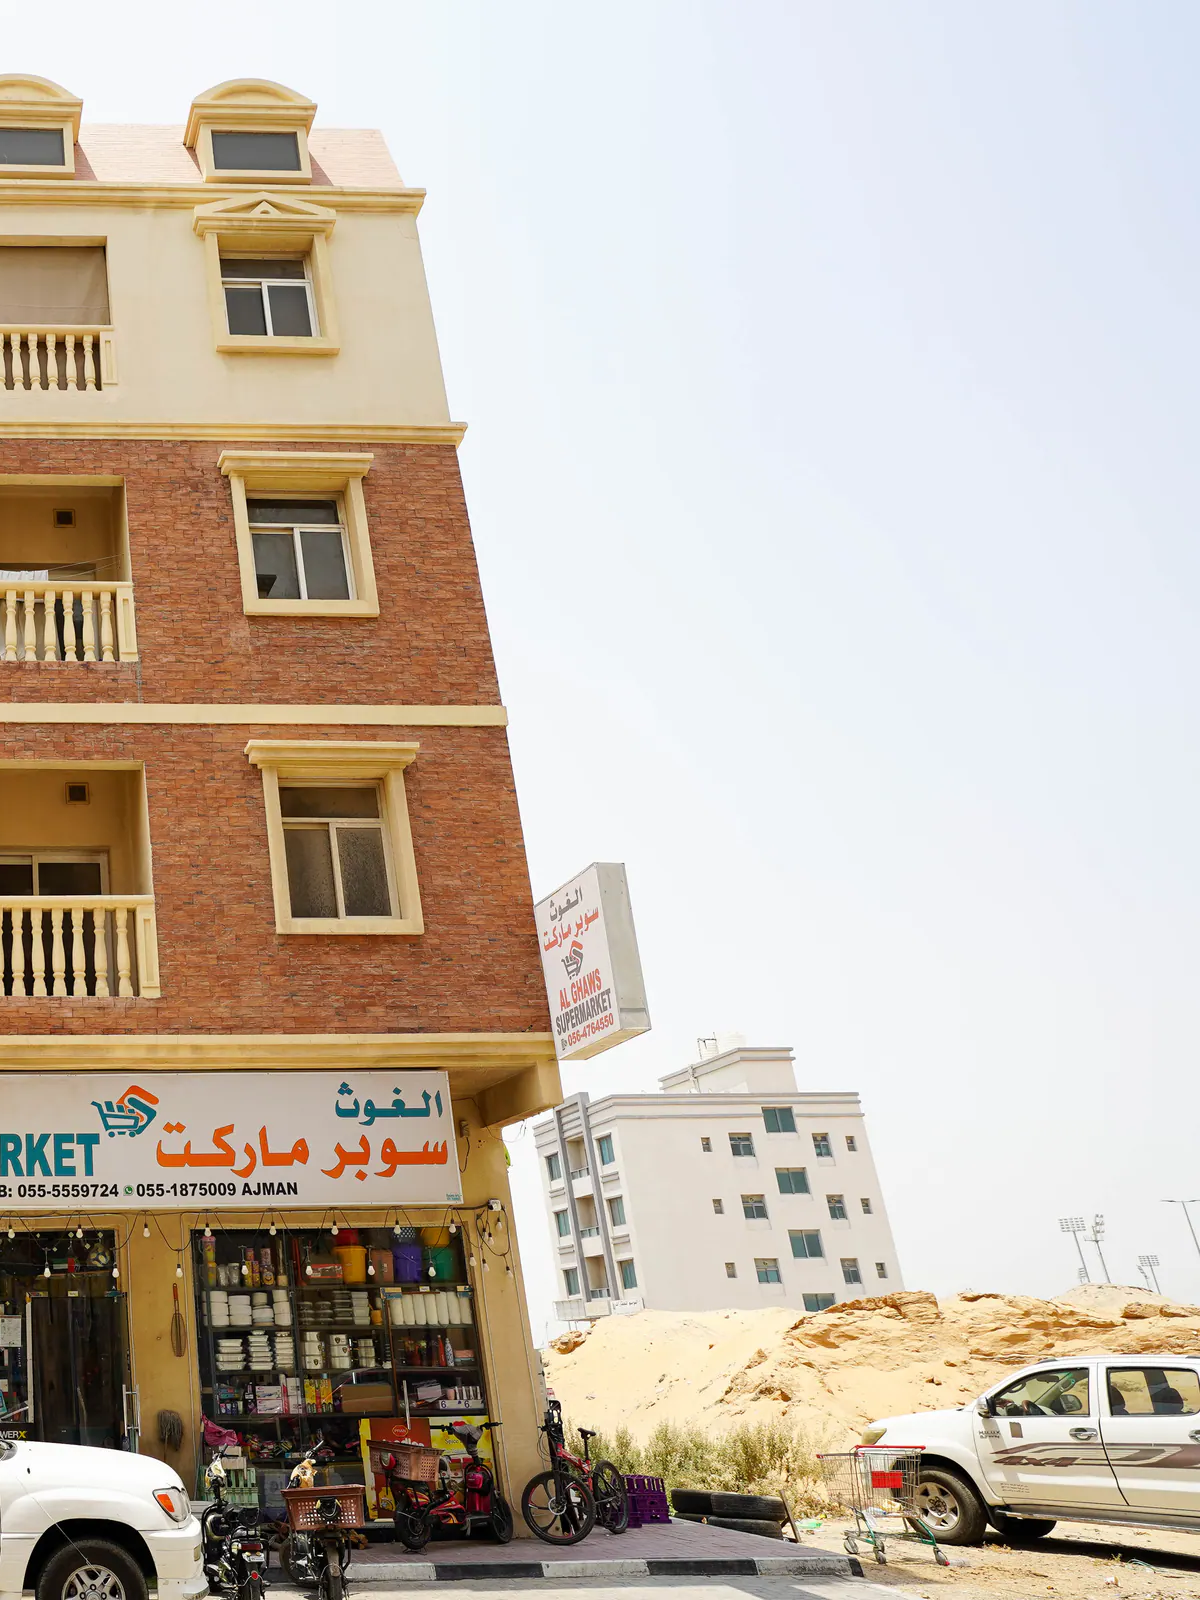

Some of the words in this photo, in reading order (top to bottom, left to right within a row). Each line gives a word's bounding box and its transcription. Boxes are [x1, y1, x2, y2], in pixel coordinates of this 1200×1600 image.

[549, 885, 583, 922] الغوث
[574, 907, 599, 938] سوبر
[543, 922, 572, 952] ماركت
[559, 987, 571, 1012] AL
[570, 968, 602, 1005] GHAWS
[555, 988, 612, 1036] SUPERMARKET
[567, 1012, 614, 1047] 056-4764550
[335, 1081, 443, 1127] الغوث
[156, 1121, 310, 1179] ماركت
[320, 1134, 449, 1182] سوبر
[17, 1184, 119, 1198] 055-5559724
[136, 1182, 237, 1198] 055-1875009
[241, 1181, 298, 1197] AJMAN
